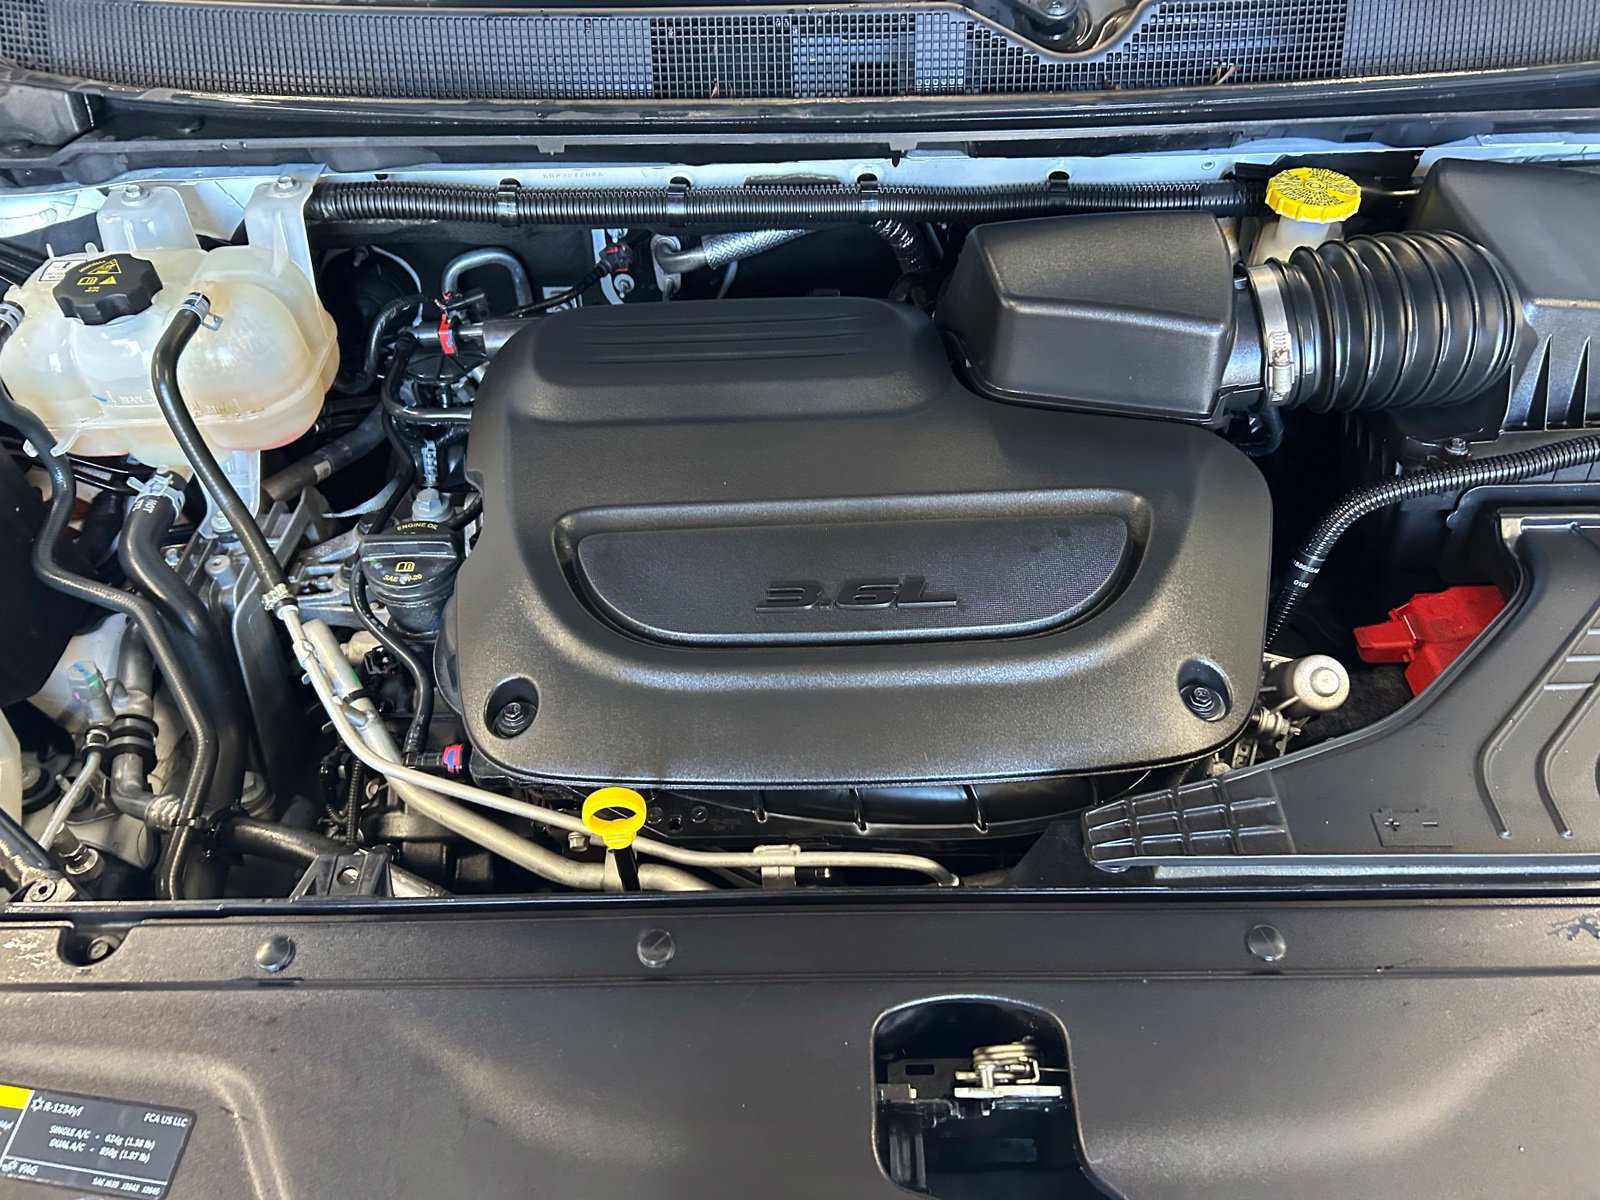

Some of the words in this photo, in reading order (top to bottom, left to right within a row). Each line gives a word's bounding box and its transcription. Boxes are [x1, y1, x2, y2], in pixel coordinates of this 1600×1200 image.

[397, 522, 426, 531] ENGINE
[383, 574, 399, 583] SAE
[755, 575, 958, 614] 3.6L
[43, 1101, 84, 1118] R-1234yf
[143, 1112, 160, 1124] FCA
[160, 1114, 173, 1126] US
[173, 1116, 189, 1128] LLC
[48, 1125, 77, 1137] SINGLE
[74, 1129, 92, 1140] A/C
[104, 1133, 124, 1146] 624g
[124, 1136, 145, 1148] (1.38
[143, 1140, 156, 1151] lb)
[48, 1138, 70, 1149] DUAL
[69, 1142, 87, 1152] A/C
[98, 1146, 119, 1159] 850g
[119, 1149, 140, 1161] (1.87
[138, 1152, 151, 1164] lb)
[18, 1162, 39, 1176] PAG
[91, 1177, 105, 1187] SAE
